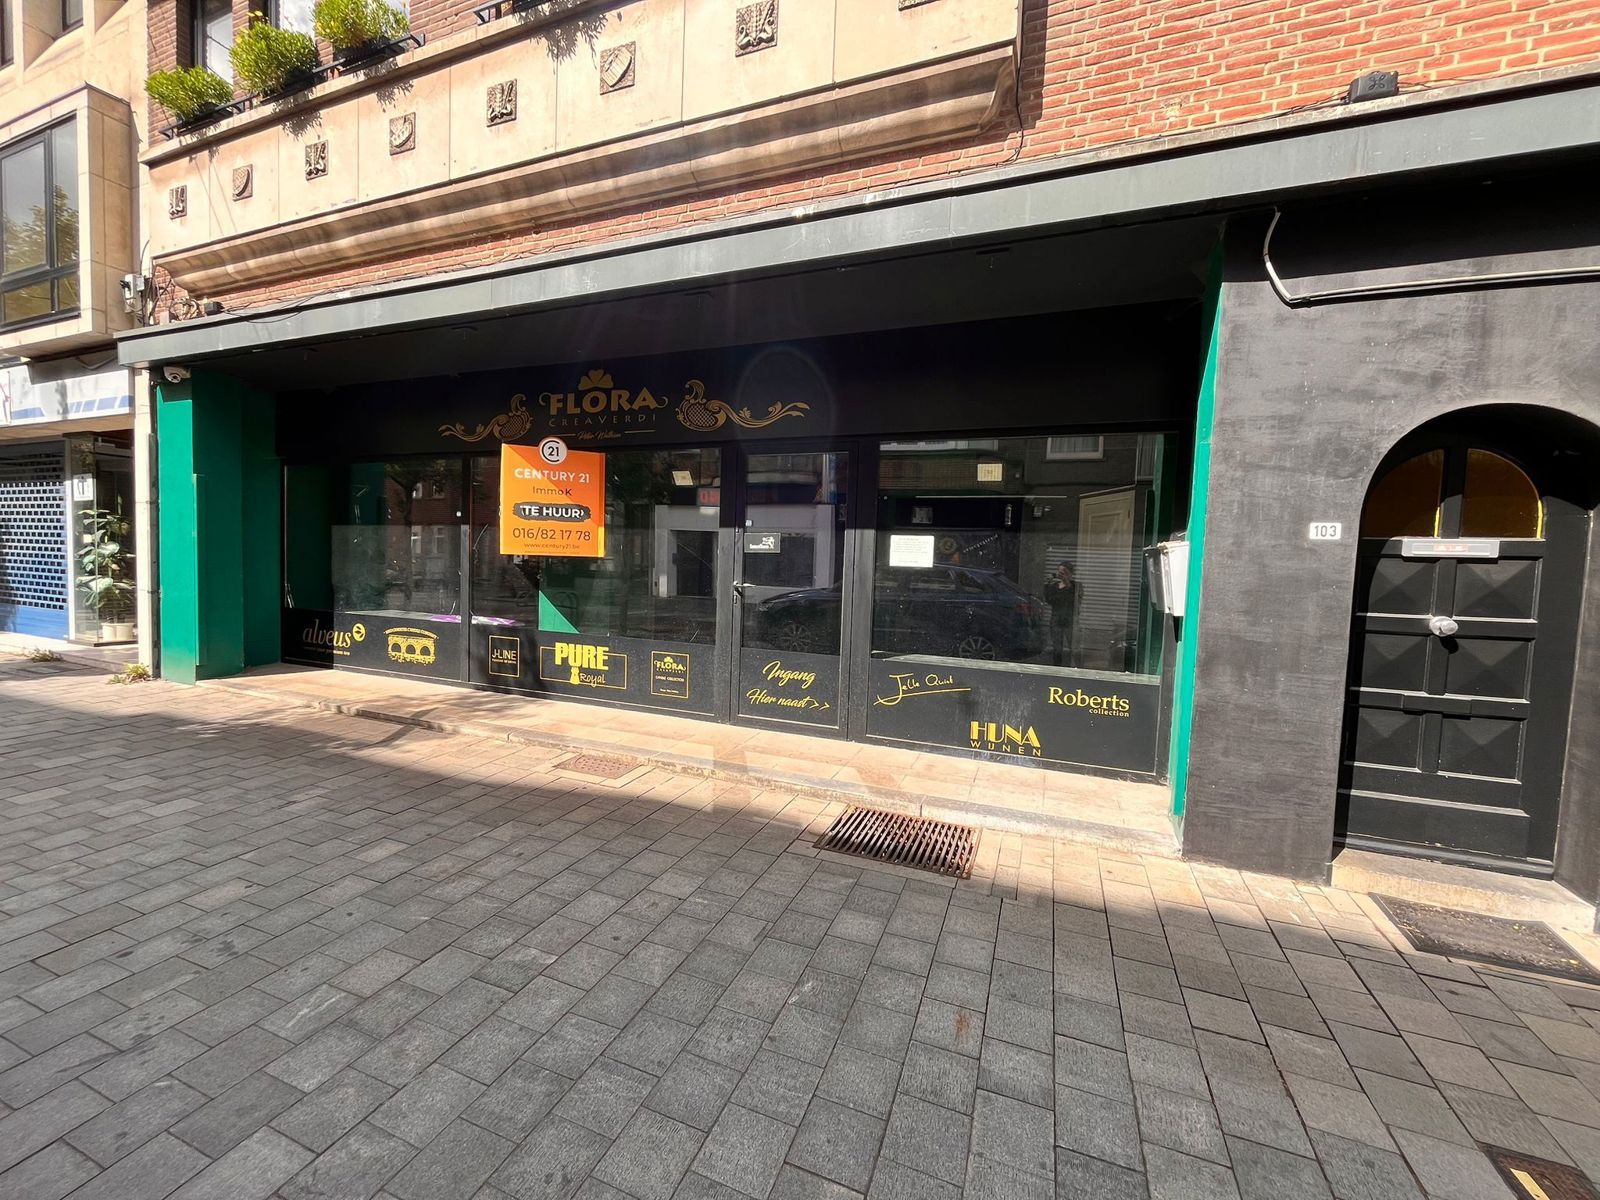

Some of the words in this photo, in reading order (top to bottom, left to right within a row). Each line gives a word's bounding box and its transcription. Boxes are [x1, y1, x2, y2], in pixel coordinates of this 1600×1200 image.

[540, 387, 668, 416] FLORA
[549, 414, 656, 427] CREAVERDI
[514, 468, 575, 482] CENTURY
[578, 473, 590, 483] 21
[512, 526, 556, 541] 016/82
[559, 530, 572, 540] 17
[575, 530, 591, 541] 78
[1313, 524, 1338, 538] 103
[302, 618, 352, 649] alveus
[554, 642, 610, 671] PURE
[654, 660, 686, 671] FLORA
[579, 672, 606, 687] Royal
[762, 660, 817, 689] Ingang
[746, 688, 777, 705] Hier
[777, 696, 811, 708] naast
[877, 673, 920, 706] Jelle
[1047, 686, 1130, 712] Roberts
[1088, 708, 1130, 718] collection
[970, 720, 1041, 748] HUNA
